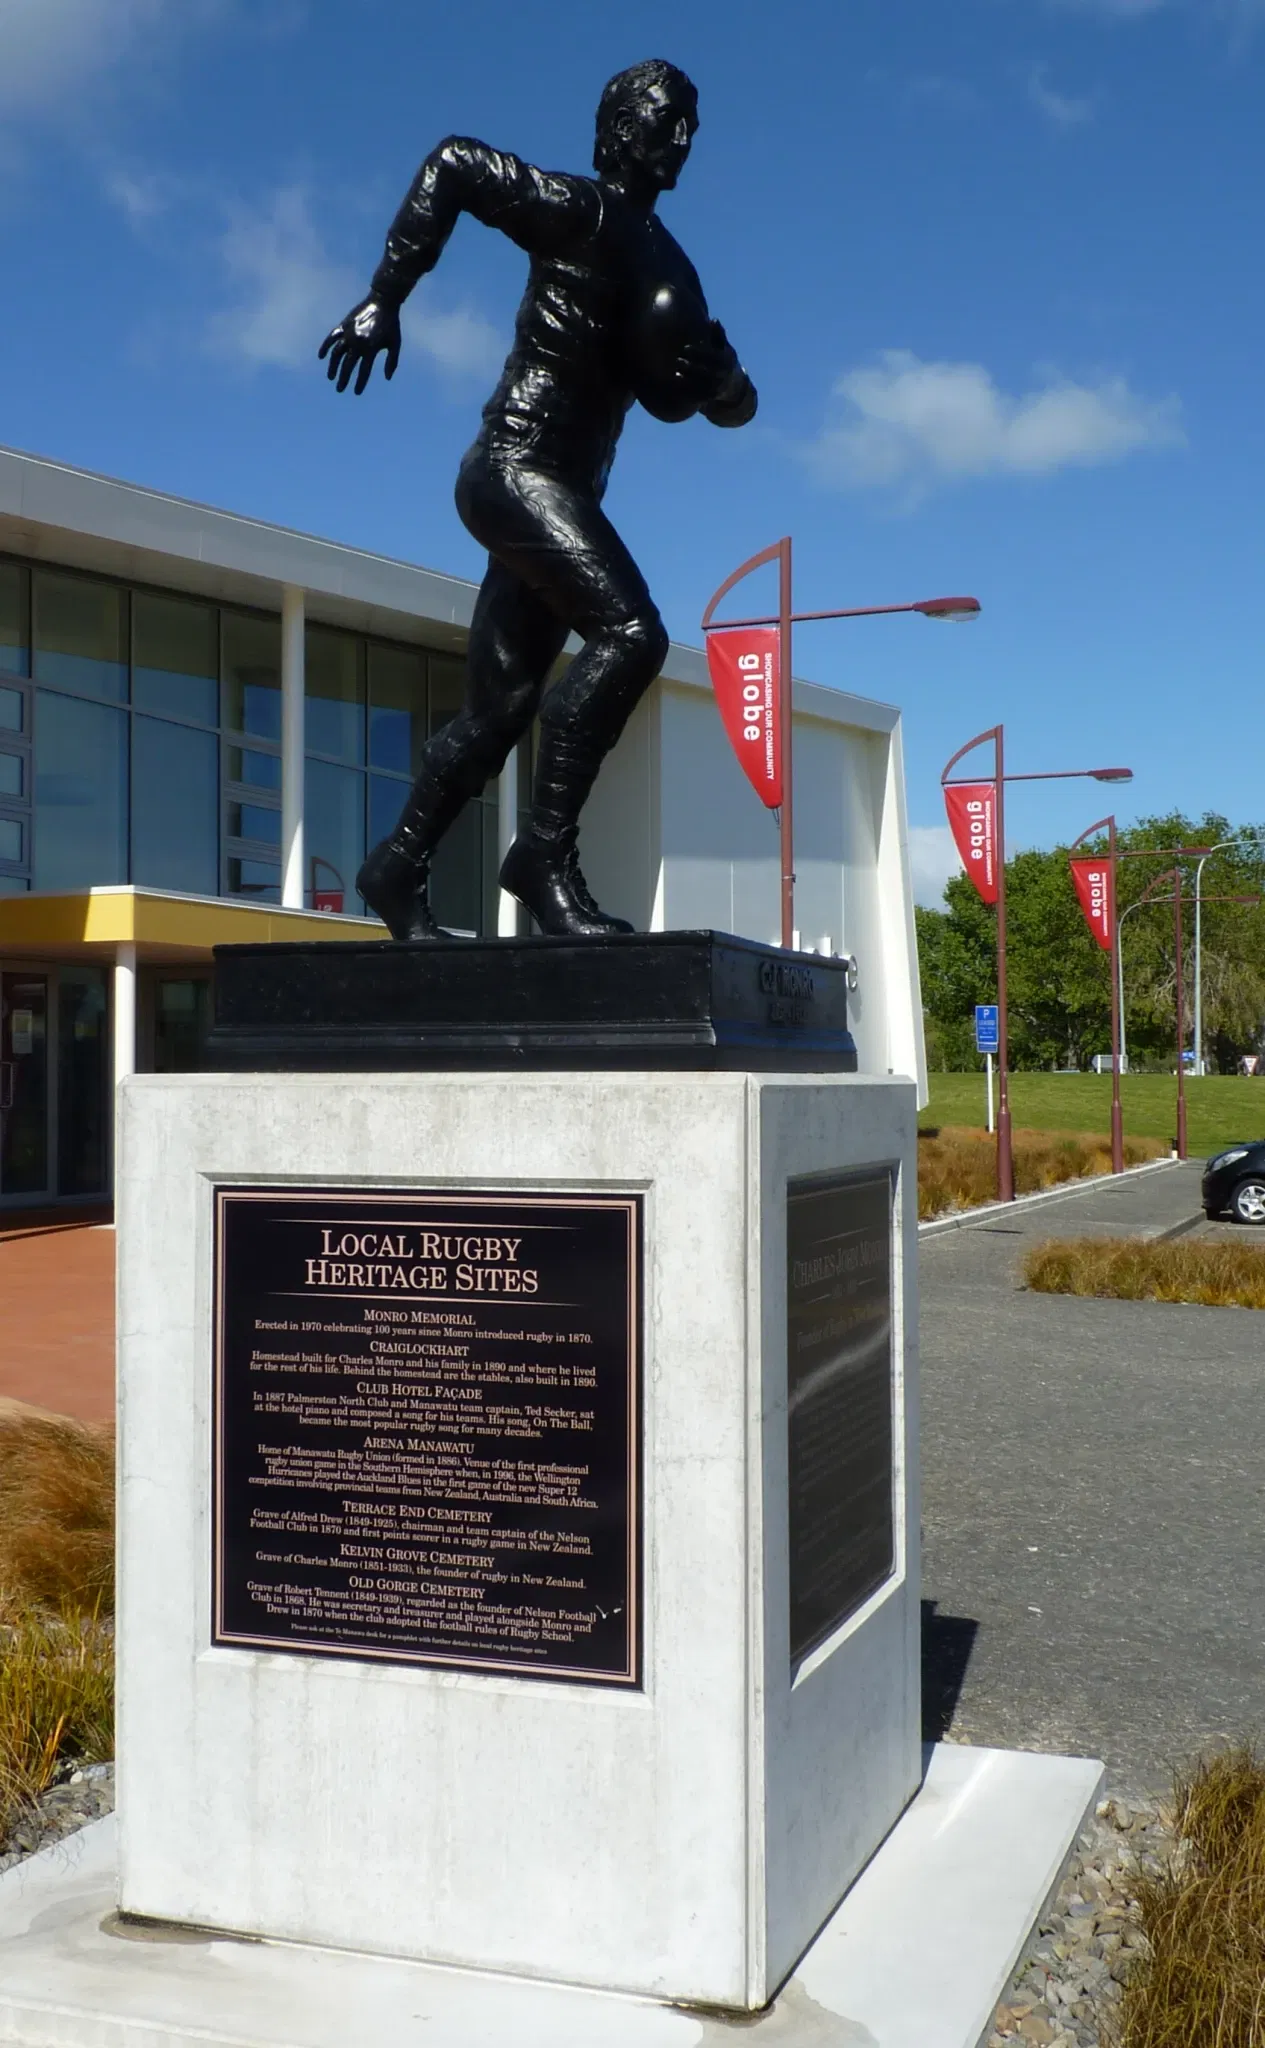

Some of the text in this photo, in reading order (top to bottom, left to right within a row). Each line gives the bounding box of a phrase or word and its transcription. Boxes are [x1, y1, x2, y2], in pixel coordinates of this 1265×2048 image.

[738, 653, 765, 741] globe
[764, 653, 774, 780] SHOWCASING OUR COMMUNITY
[966, 800, 986, 860] globe
[1088, 872, 1103, 917] globe
[321, 1230, 522, 1261] LOCAL RUGBY
[305, 1259, 538, 1293] HERITAGE SITES
[364, 1309, 476, 1325] MONRO MEMORIAL
[255, 1320, 287, 1330] Erected
[290, 1321, 298, 1330] in
[302, 1322, 321, 1331] 1970
[323, 1322, 372, 1335] celebrating
[375, 1325, 390, 1334] 100
[392, 1328, 416, 1336] years
[418, 1327, 441, 1336] since
[444, 1327, 473, 1337] Monro
[475, 1329, 524, 1340] introduced
[526, 1332, 553, 1343] rugby
[556, 1333, 565, 1342] in
[370, 1341, 469, 1356] CRAIGLOCKHART
[250, 1361, 262, 1370] for
[264, 1362, 278, 1371] the
[280, 1364, 297, 1372] rest
[299, 1363, 308, 1372] of
[309, 1364, 322, 1373] his
[344, 1365, 375, 1375] Behind
[377, 1367, 391, 1376] the
[394, 1367, 441, 1379] homestead
[461, 1371, 476, 1380] the
[515, 1374, 534, 1383] also
[536, 1375, 558, 1385] built
[561, 1376, 570, 1386] in
[252, 1351, 596, 1376] Homestead built for Charles Monro and his family in 1890 and where he lived
[357, 1382, 482, 1400] CLUB HOTEL FAÇADE
[254, 1391, 262, 1400] In
[288, 1393, 336, 1404] Palmerston
[339, 1396, 365, 1406] North
[367, 1397, 389, 1407] Club
[391, 1399, 407, 1408] and
[410, 1399, 458, 1411] Manawatu
[460, 1404, 483, 1412] team
[525, 1406, 541, 1416] Ted
[580, 1411, 594, 1419] sat
[300, 1414, 331, 1425] became
[334, 1417, 348, 1426] the
[350, 1418, 371, 1427] most
[374, 1420, 408, 1430] popular
[410, 1421, 436, 1433] rugby
[438, 1425, 459, 1434] song
[462, 1424, 474, 1433] for
[477, 1427, 502, 1437] many
[364, 1436, 474, 1454] ARENA MANAWATU
[342, 1500, 492, 1523] TERRACE END CEMETERY
[253, 1508, 279, 1519] Grave
[281, 1511, 290, 1519] of
[291, 1512, 317, 1522] Alfred
[320, 1513, 343, 1523] Drew
[402, 1520, 444, 1532] chairman
[447, 1524, 464, 1533] and
[466, 1526, 489, 1536] team
[491, 1529, 526, 1541] captain
[528, 1530, 538, 1539] of
[540, 1531, 554, 1541] the
[557, 1532, 589, 1544] Nelson
[256, 1551, 282, 1561] Grave
[284, 1554, 293, 1563] of
[294, 1555, 327, 1565] Charles
[330, 1557, 358, 1568] Monro
[417, 1565, 431, 1575] the
[434, 1566, 469, 1578] founder
[470, 1570, 481, 1579] of
[482, 1572, 508, 1584] rugby
[511, 1574, 520, 1583] in
[523, 1574, 543, 1584] New
[341, 1544, 495, 1568] KELVIN GROVE CEMETERY
[349, 1576, 485, 1599] OLD GORGE CEMETERY
[247, 1581, 272, 1591] Grave
[274, 1584, 283, 1593] of
[284, 1584, 312, 1595] Robert
[314, 1587, 349, 1599] Tennent
[407, 1598, 445, 1608] regarded
[460, 1601, 475, 1611] the
[477, 1602, 512, 1614] founder
[514, 1606, 524, 1615] of
[525, 1607, 556, 1618] Nelson
[559, 1610, 596, 1623] Football
[267, 1603, 289, 1613] Drew
[292, 1606, 300, 1615] in
[303, 1607, 323, 1617] 1870
[325, 1610, 347, 1620] when
[350, 1612, 364, 1621] the
[366, 1613, 384, 1623] club
[386, 1616, 420, 1628] adopted
[423, 1619, 437, 1628] the
[440, 1620, 472, 1632] football
[475, 1623, 497, 1634] rules
[499, 1626, 509, 1635] of
[511, 1627, 540, 1640] Rugby
